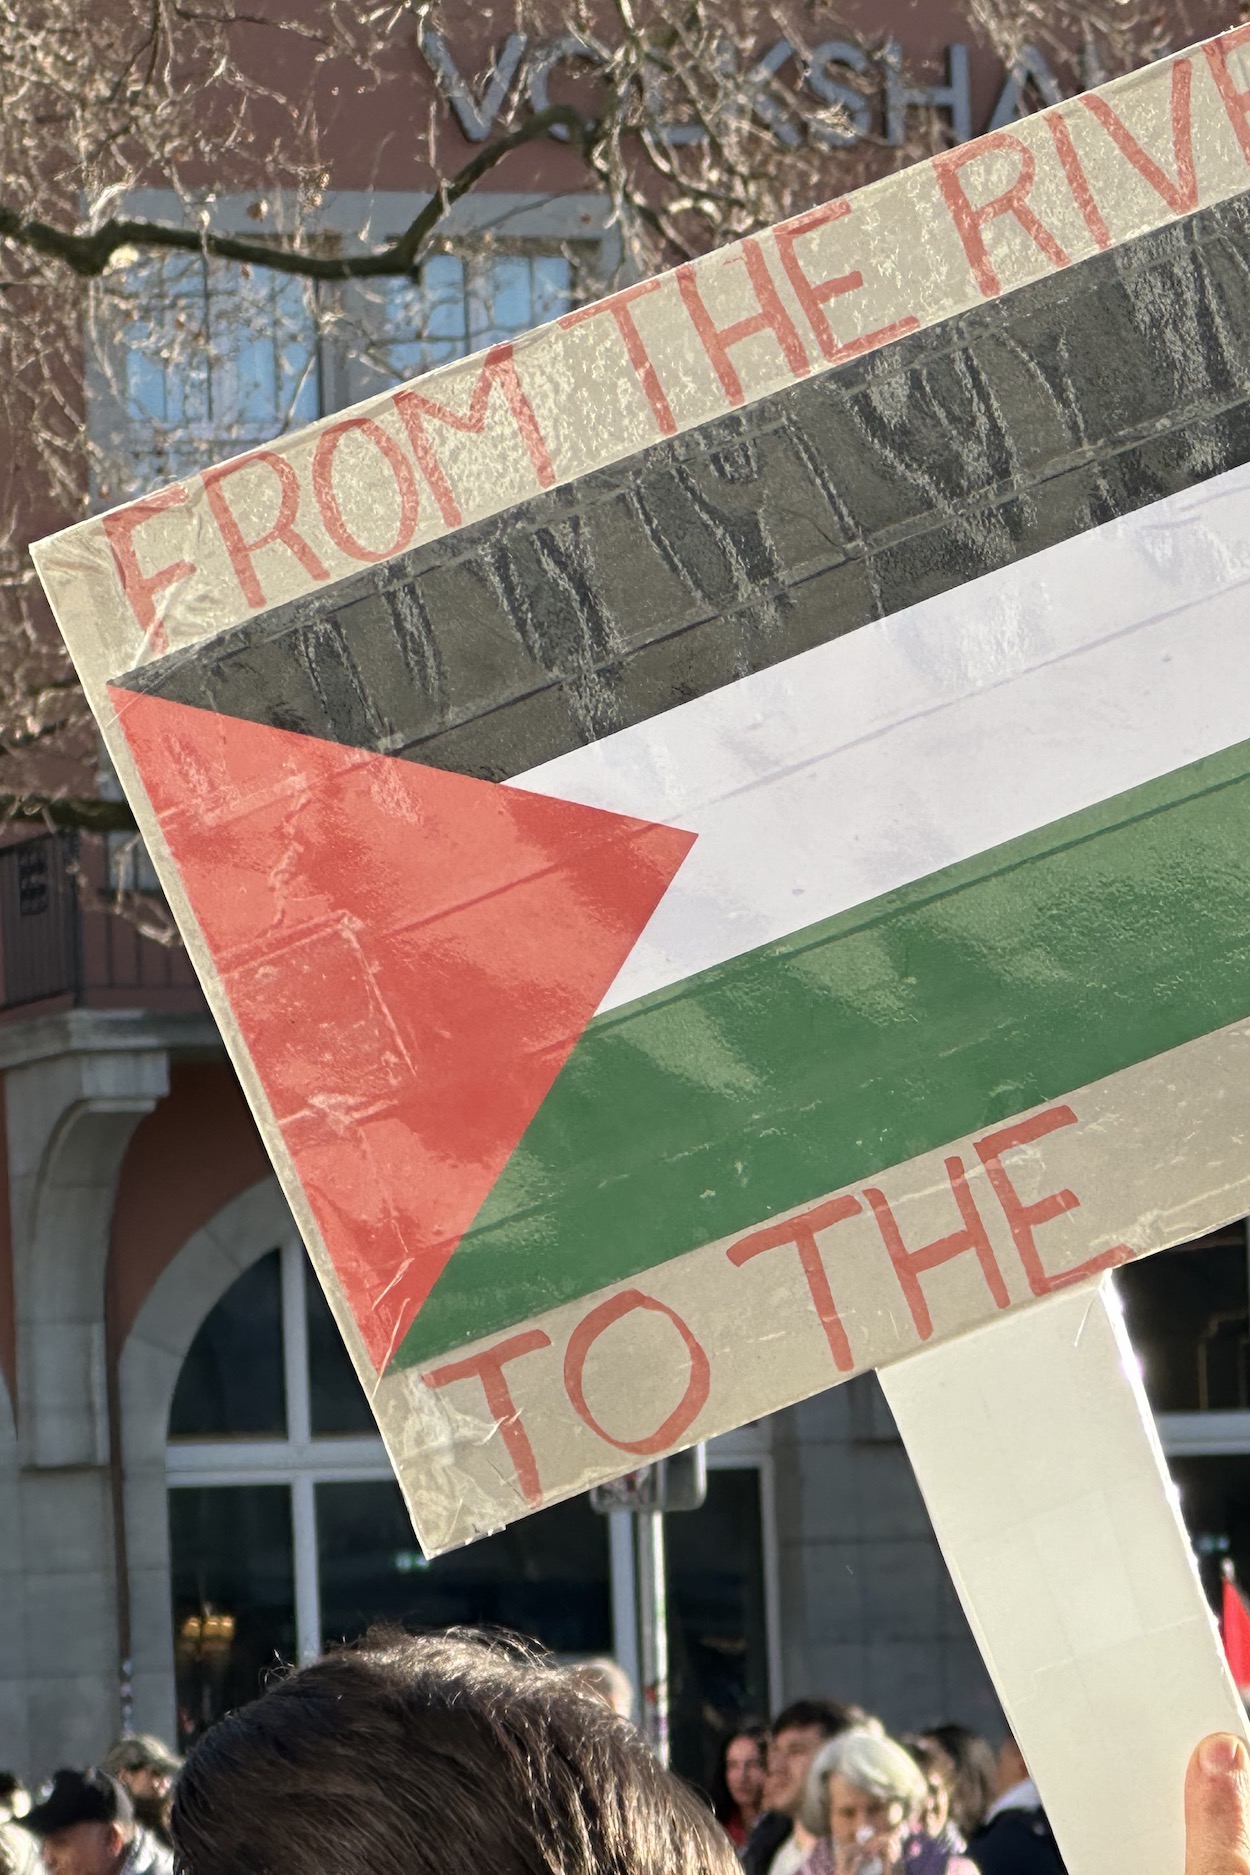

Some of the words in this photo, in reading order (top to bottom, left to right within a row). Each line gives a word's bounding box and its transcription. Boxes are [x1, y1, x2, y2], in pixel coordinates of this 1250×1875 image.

[103, 344, 556, 654] FROM
[556, 200, 920, 435] THE
[420, 1288, 710, 1508] TO
[726, 1104, 1136, 1372] THE
